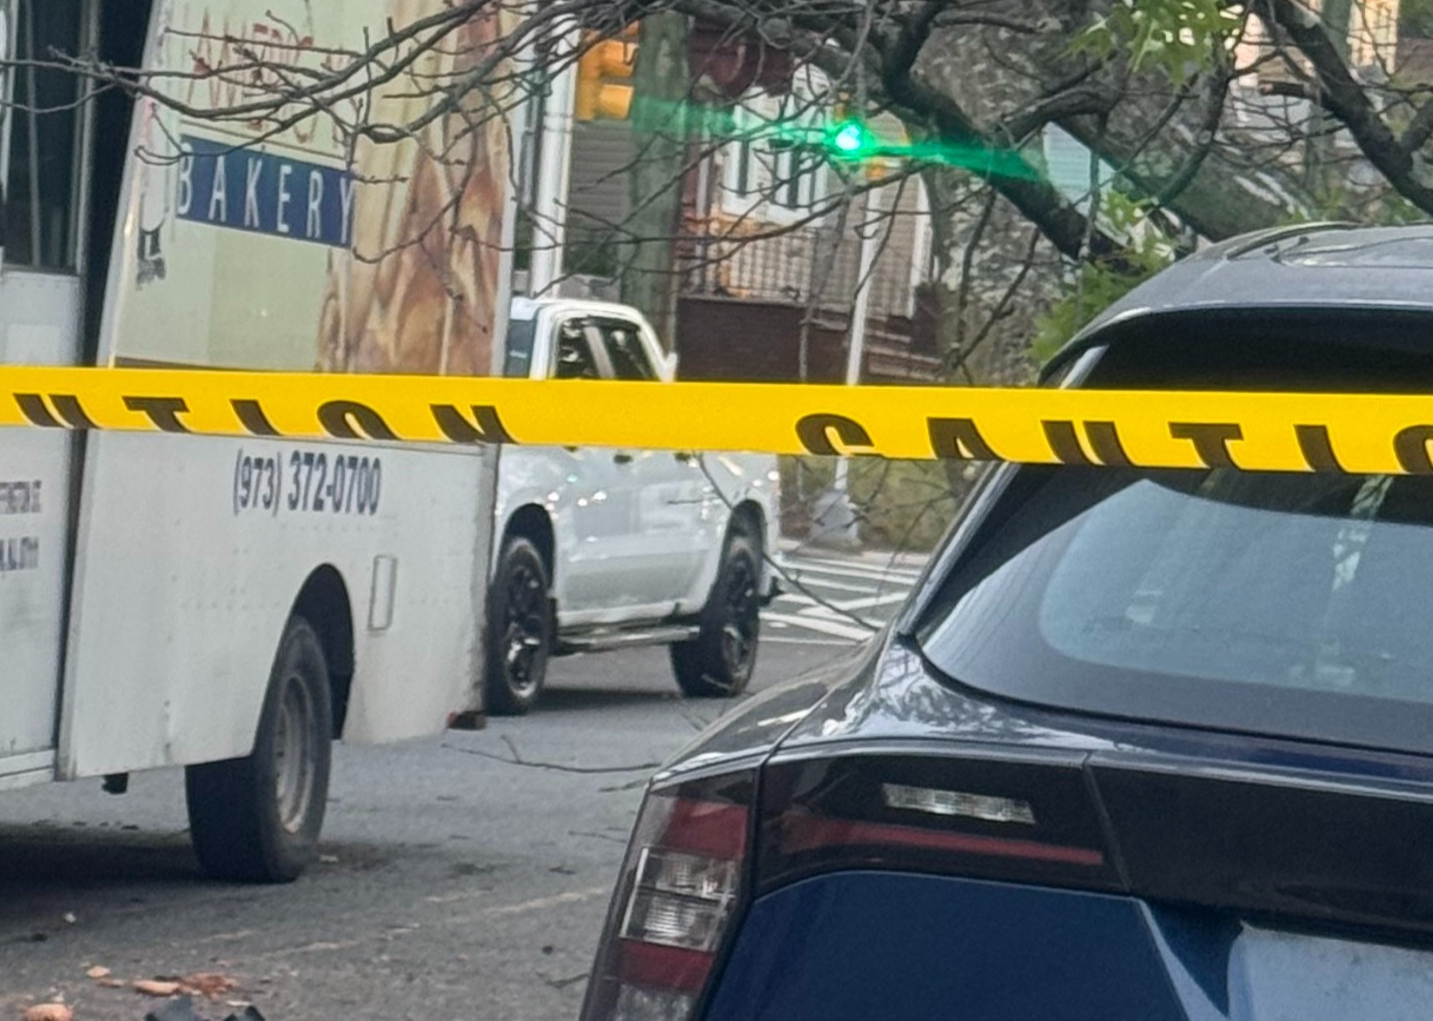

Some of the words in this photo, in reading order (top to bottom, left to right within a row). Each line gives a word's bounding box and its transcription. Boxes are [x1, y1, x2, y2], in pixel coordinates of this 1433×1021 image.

[178, 142, 354, 241] BAKERY
[233, 449, 282, 518] (973)
[288, 450, 382, 516] 372-0700
